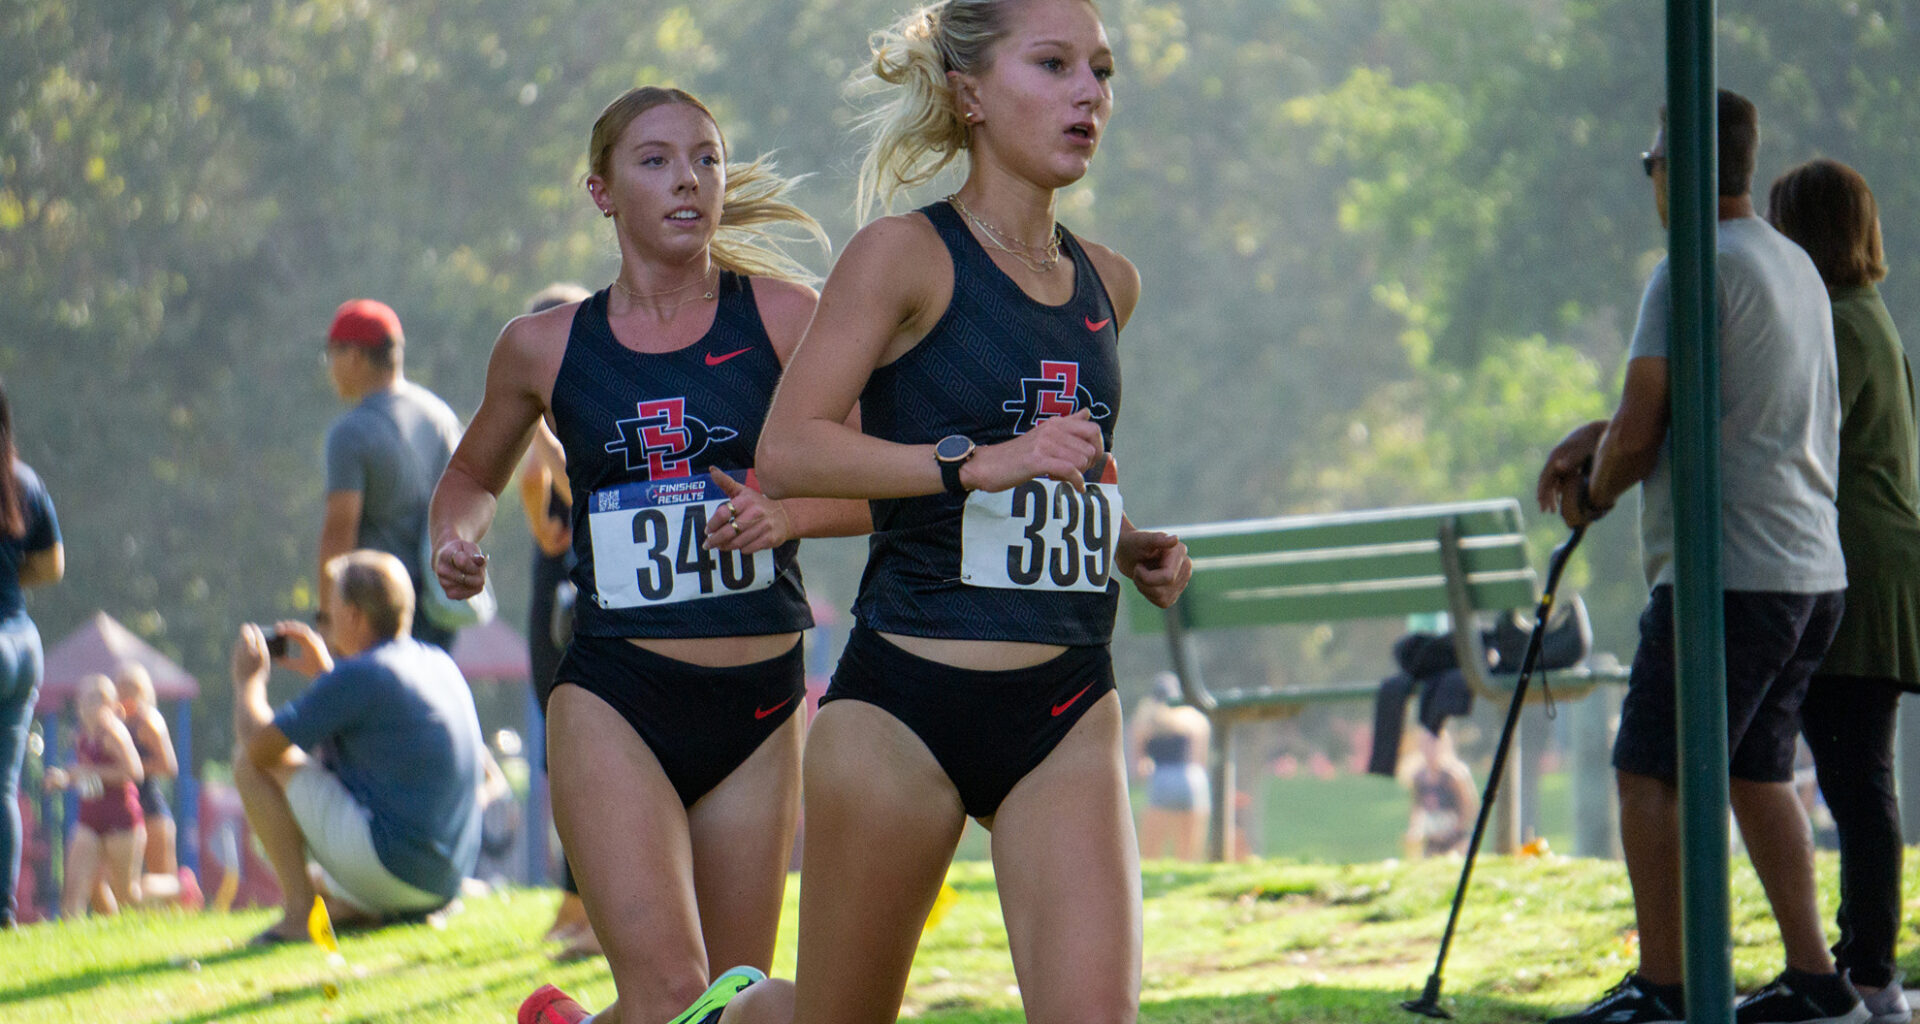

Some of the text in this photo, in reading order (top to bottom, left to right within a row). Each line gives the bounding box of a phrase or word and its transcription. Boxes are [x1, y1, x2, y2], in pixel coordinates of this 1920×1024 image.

[659, 481, 705, 493] FINISHED
[658, 491, 704, 504] RESULTS
[1007, 480, 1111, 586] 339
